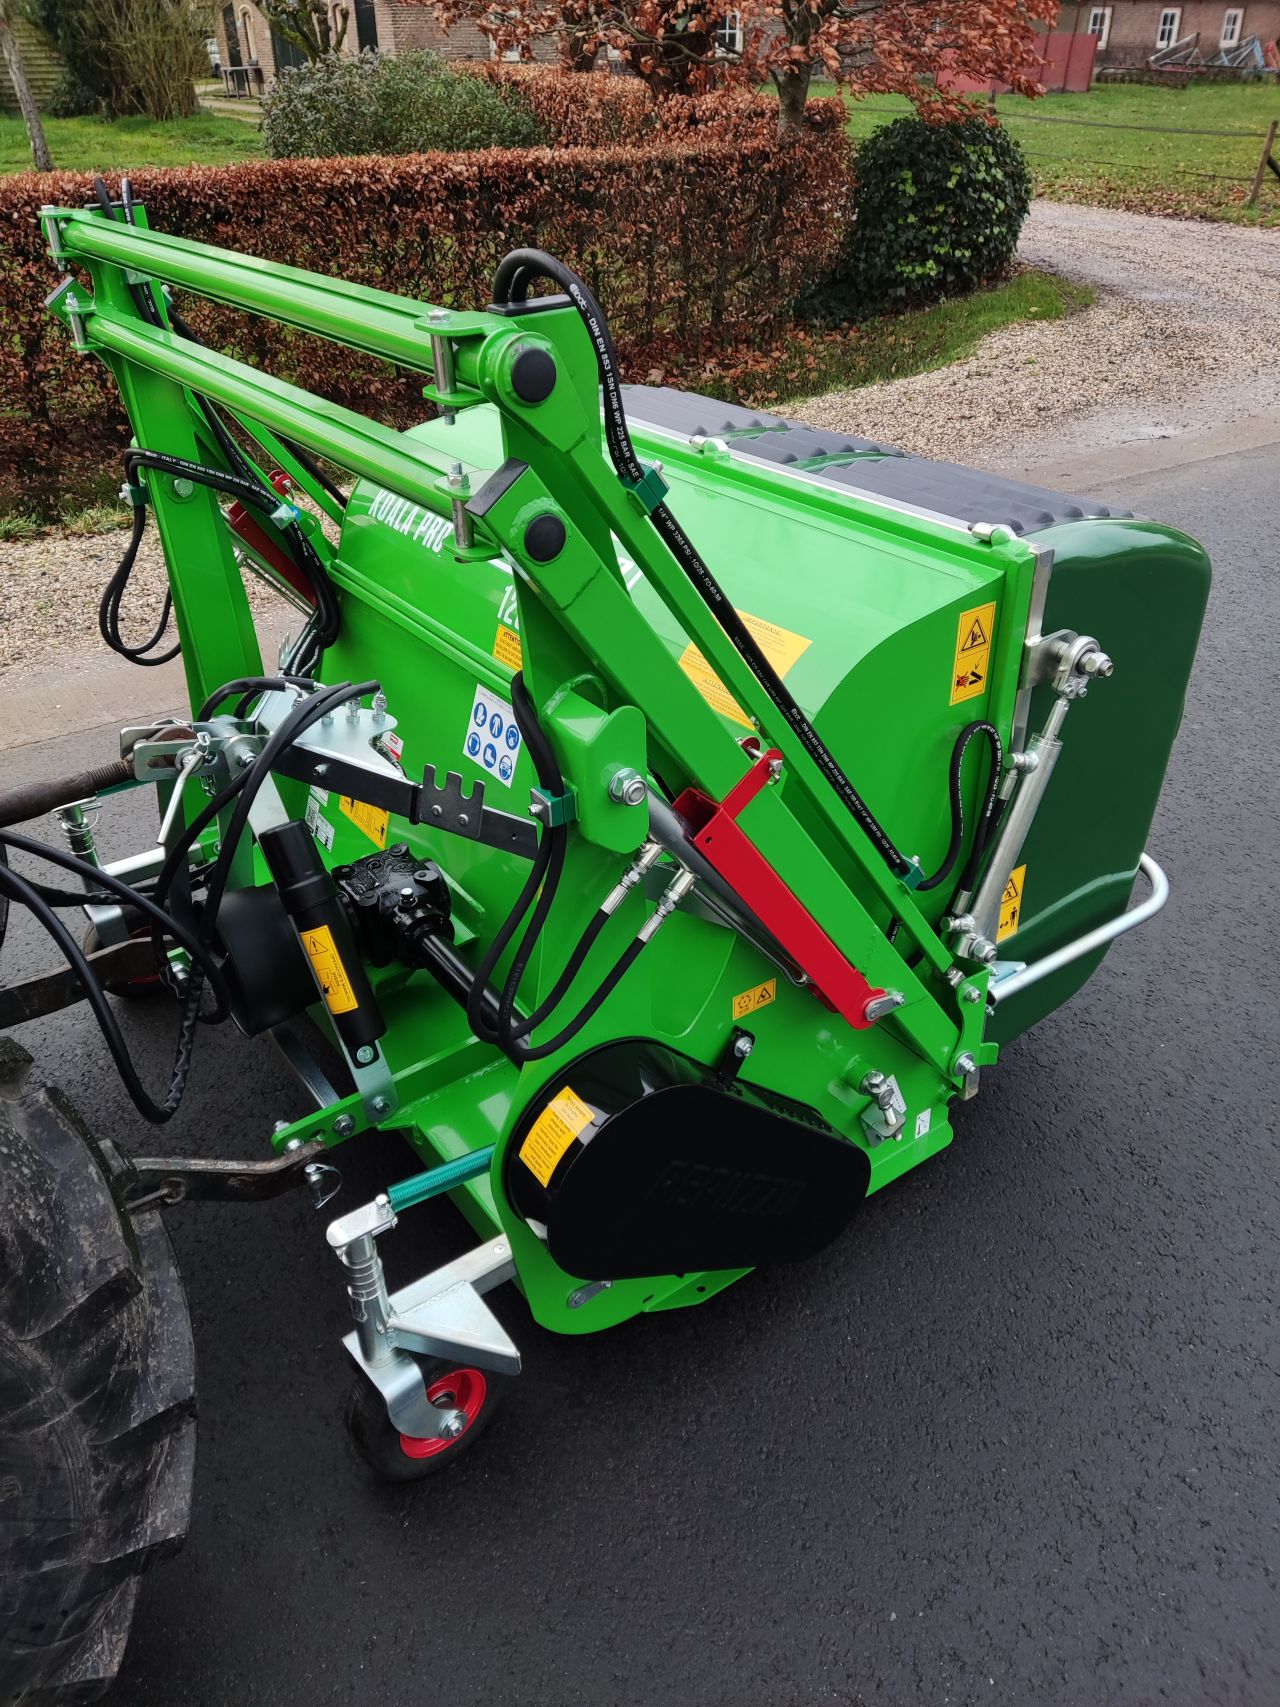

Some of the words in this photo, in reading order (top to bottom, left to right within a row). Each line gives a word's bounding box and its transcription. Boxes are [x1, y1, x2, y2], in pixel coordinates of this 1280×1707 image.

[589, 317, 601, 336] DIN
[596, 337, 606, 352] EN
[601, 353, 611, 370] 853
[606, 372, 615, 390] 1SN
[610, 391, 619, 409] DN6
[614, 410, 622, 424] WP
[617, 426, 625, 440] 225
[620, 441, 630, 458] BAR
[628, 462, 639, 477] SAE
[368, 489, 415, 536] KOALA
[414, 509, 453, 553] PRO
[666, 519, 675, 530] WP
[673, 531, 685, 545] 3265
[682, 544, 691, 555] PSI
